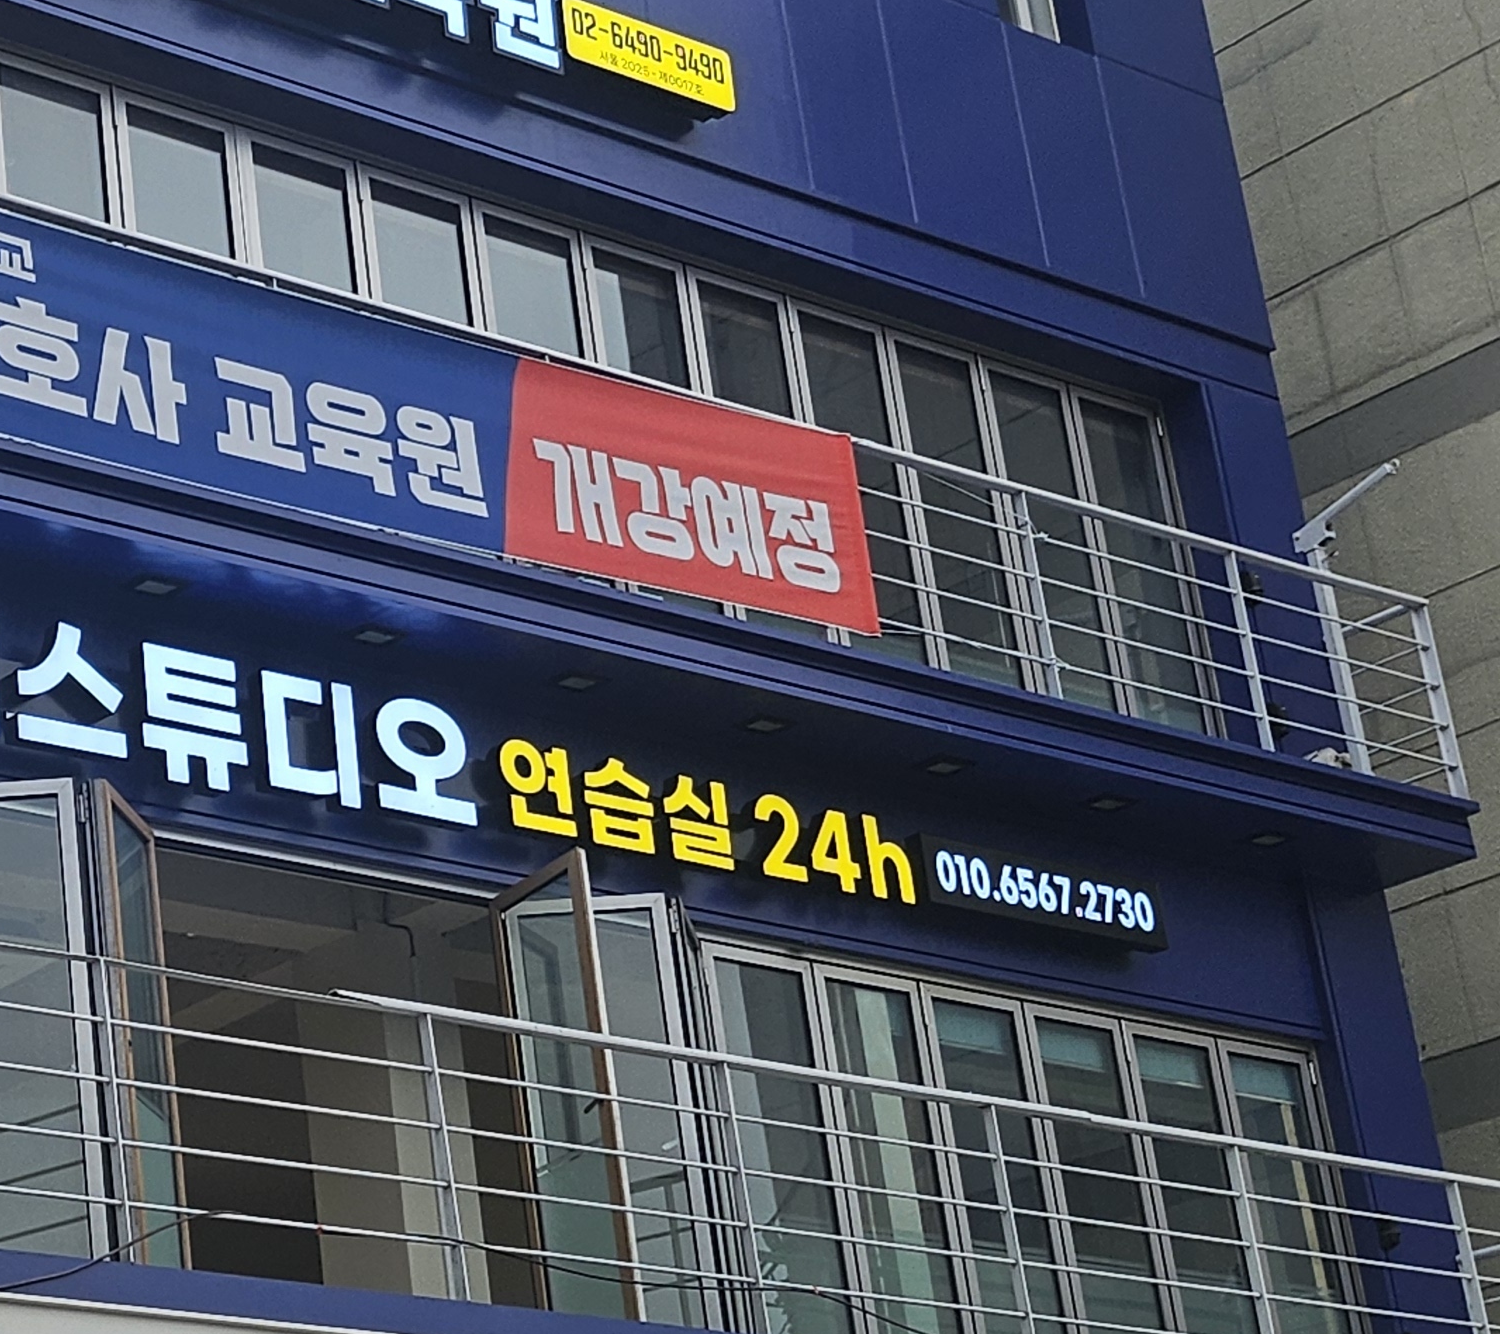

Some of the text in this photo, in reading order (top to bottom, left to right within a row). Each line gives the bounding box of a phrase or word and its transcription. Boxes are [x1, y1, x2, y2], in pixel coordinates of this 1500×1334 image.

[571, 6, 725, 85] 02-6490-9490
[214, 355, 490, 518] 교육원
[532, 437, 842, 594] 개강예정
[498, 738, 736, 872] 연습실
[753, 792, 917, 905] 24h
[934, 849, 1155, 933] 010.6567.2730
